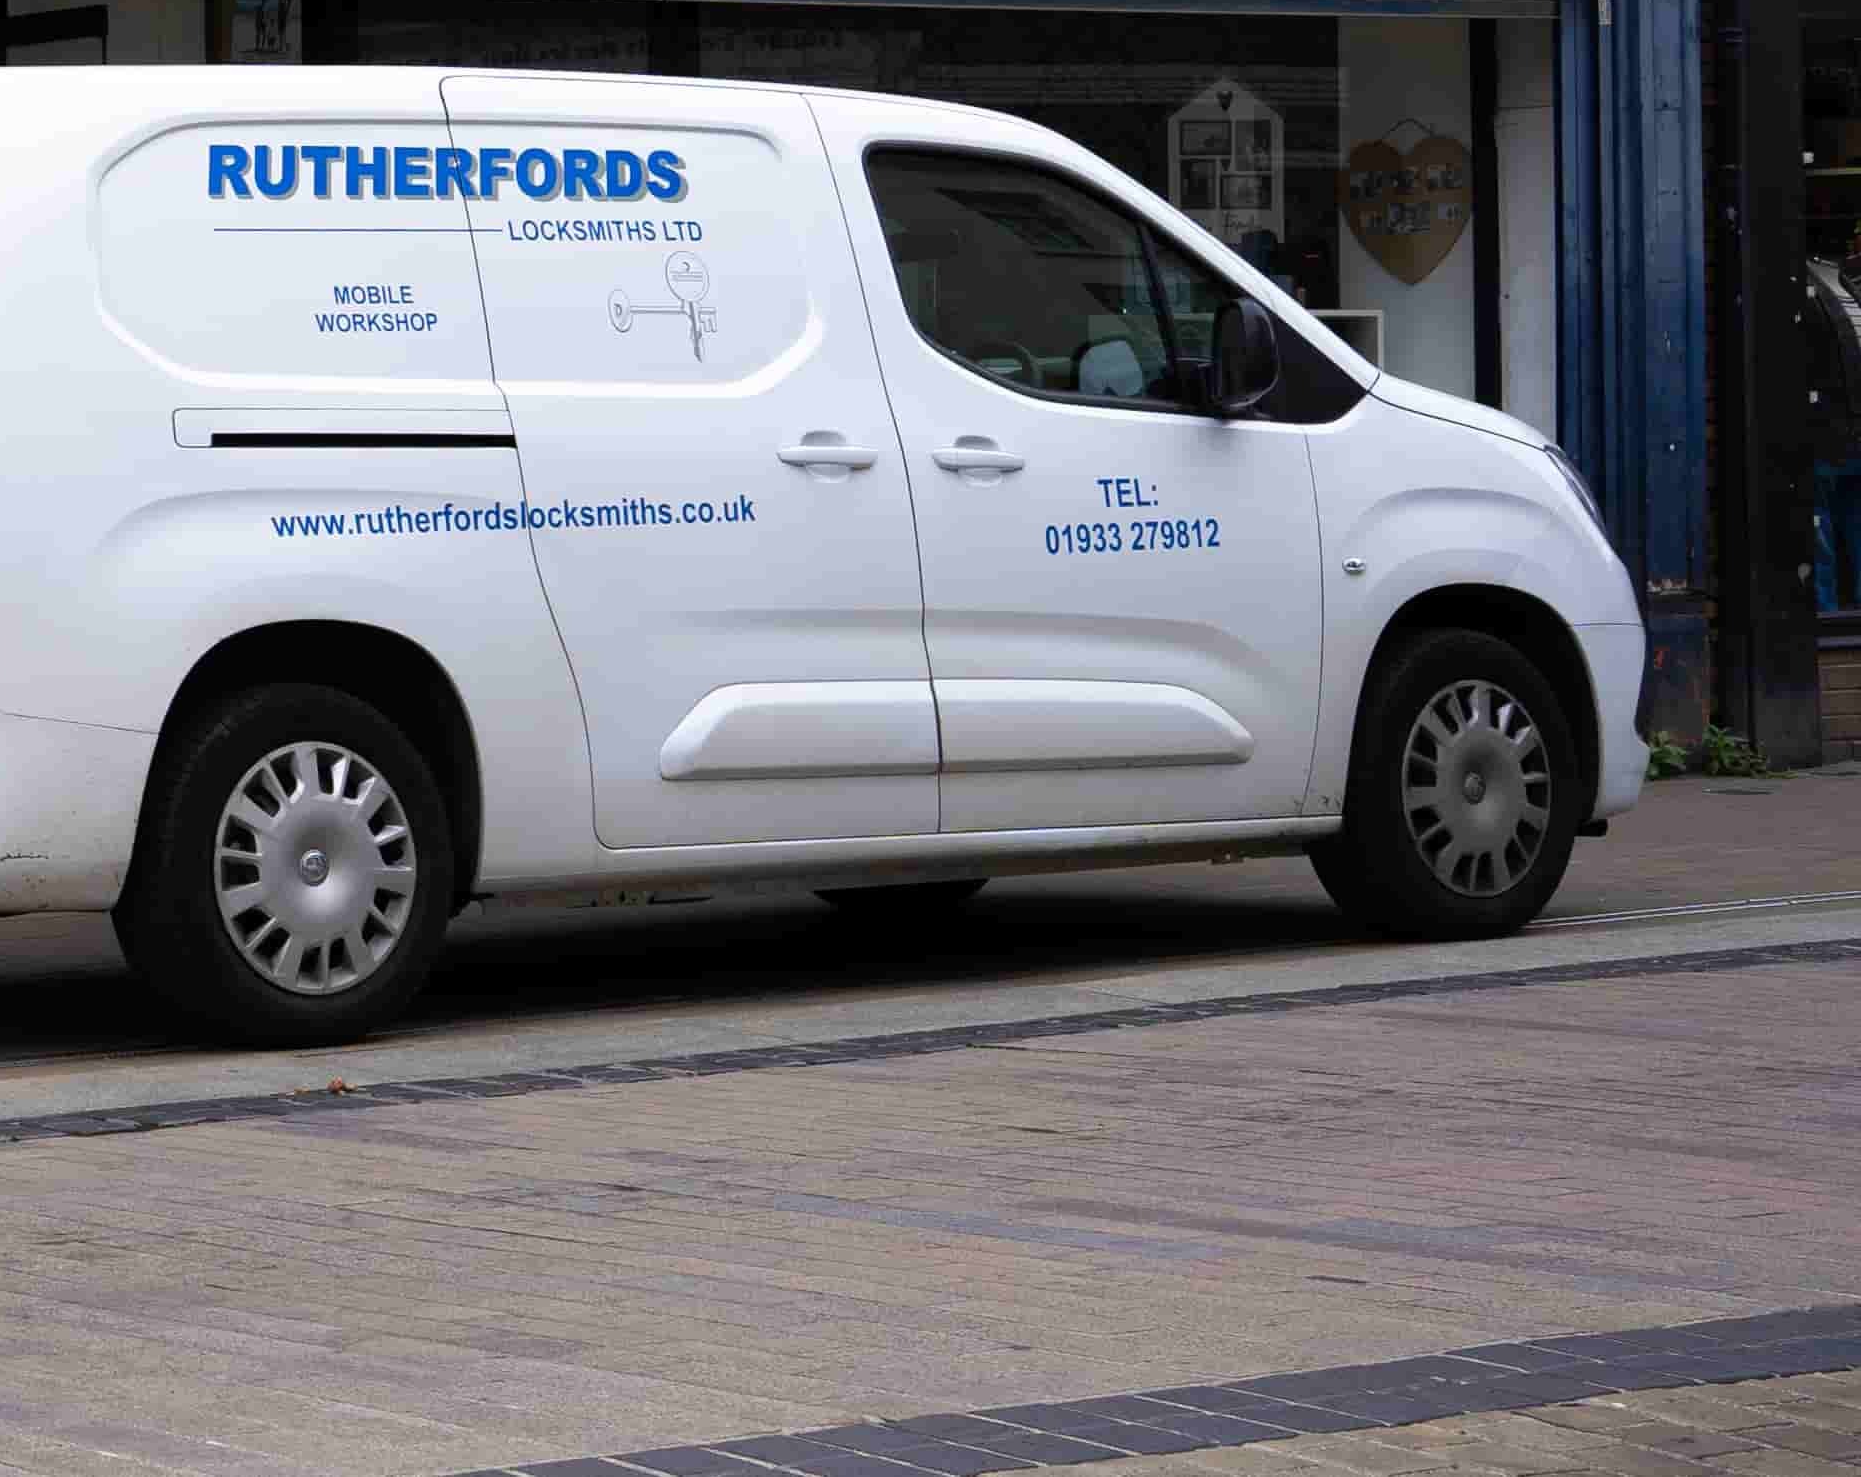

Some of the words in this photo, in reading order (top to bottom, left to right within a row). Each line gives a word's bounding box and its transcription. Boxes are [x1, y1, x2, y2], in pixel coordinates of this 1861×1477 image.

[208, 144, 689, 203] RUTHERFORDS
[507, 219, 656, 243] LOCKSMITHS
[662, 220, 703, 243] LTD
[333, 285, 415, 305] MOBILE
[315, 312, 439, 333] WORKSHOP
[1097, 478, 1159, 507] TEL:
[270, 495, 756, 538] www.rutherfordslocksmiths.co.uk
[1045, 524, 1123, 555] 01933
[1130, 518, 1220, 551] 279812
